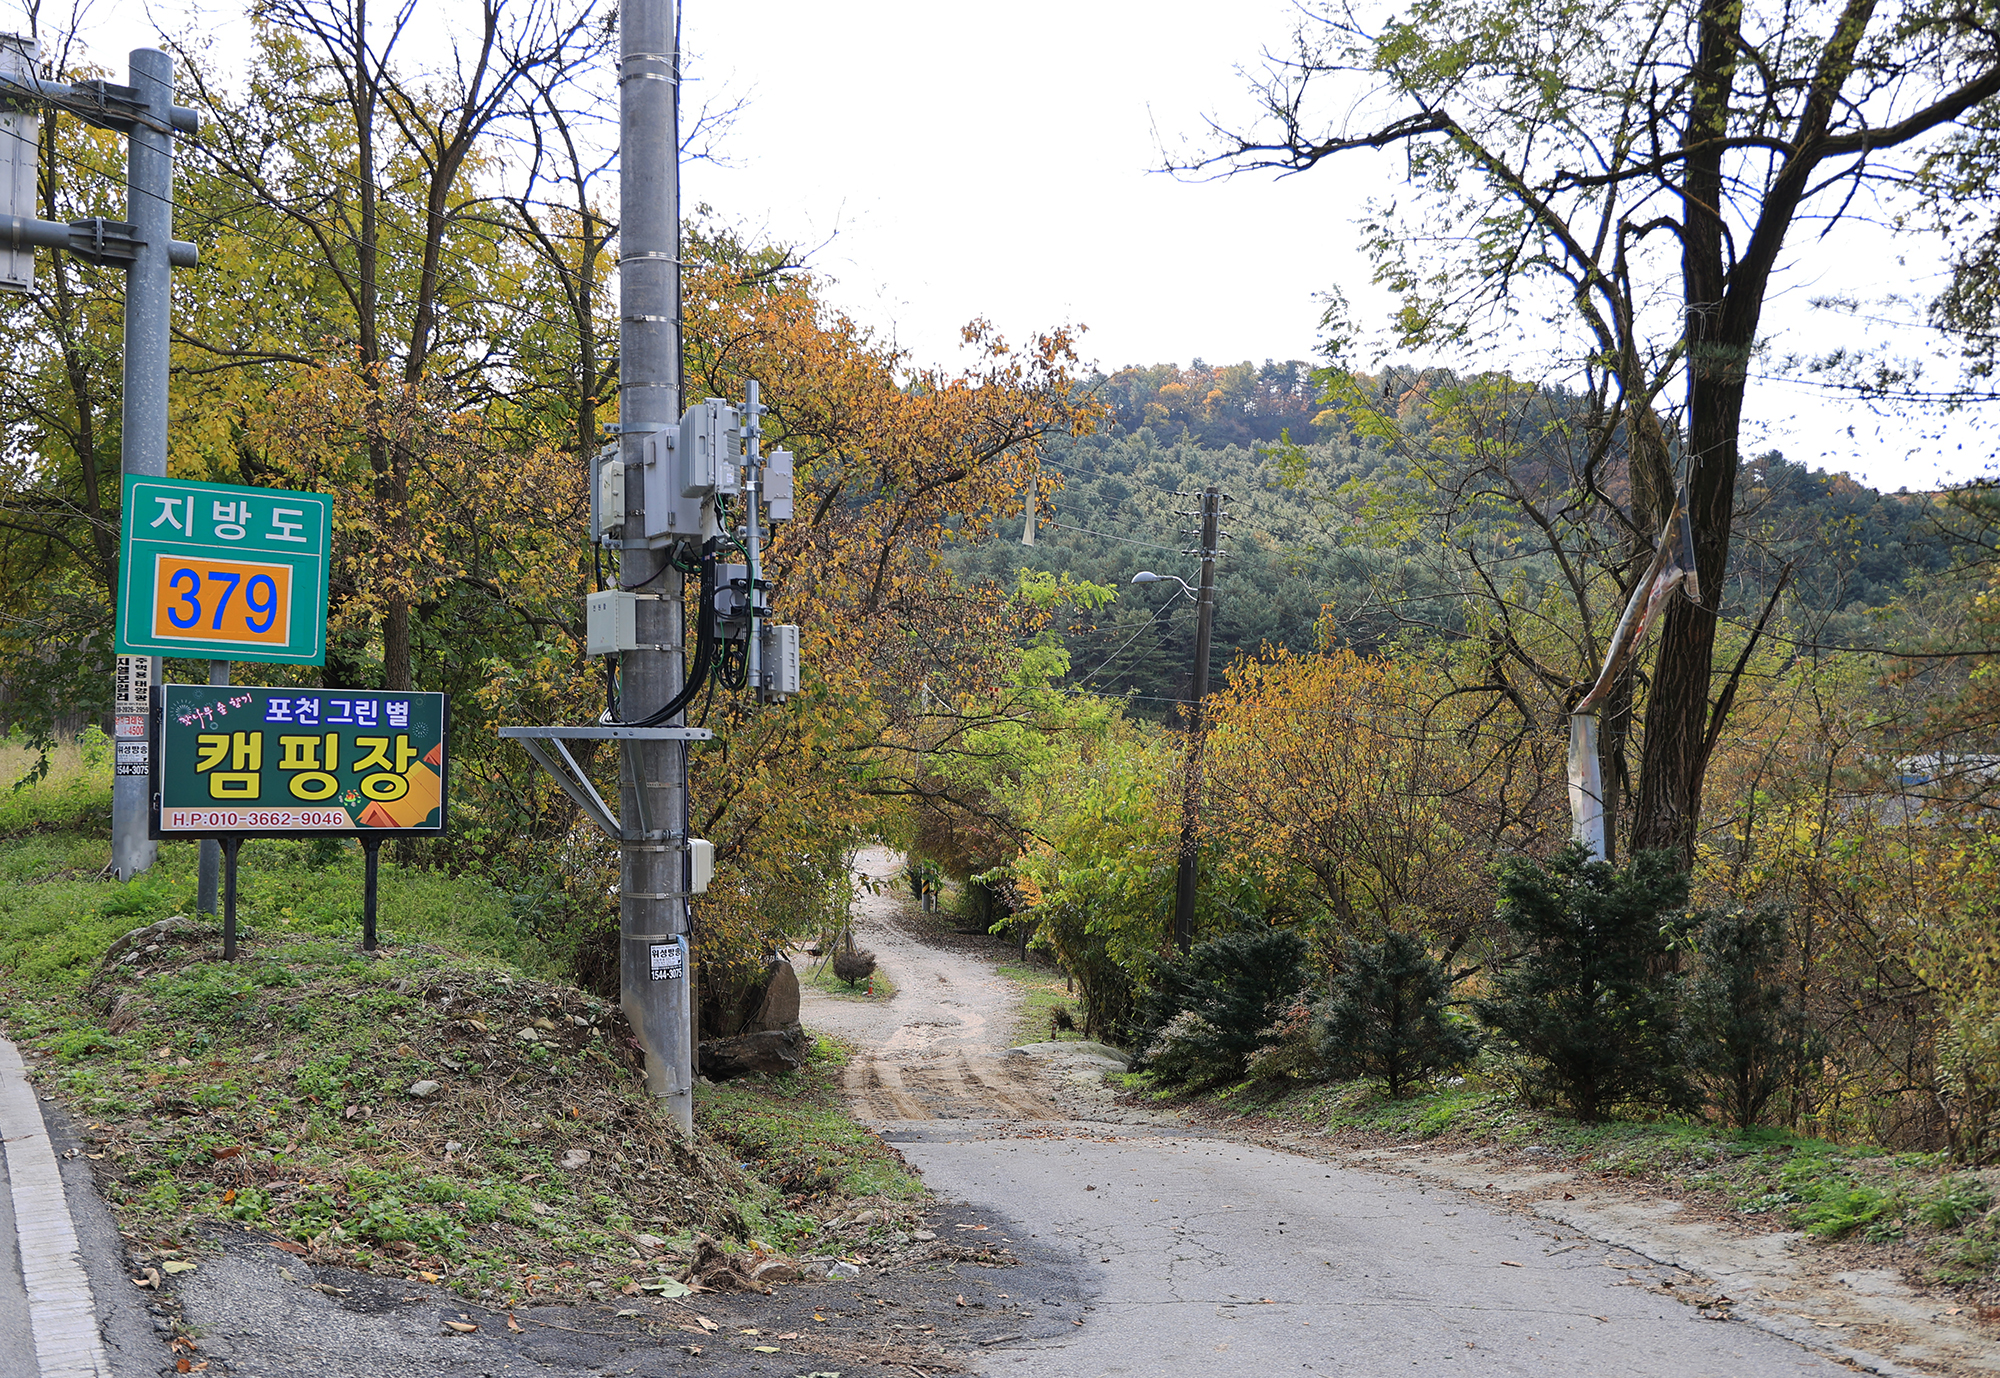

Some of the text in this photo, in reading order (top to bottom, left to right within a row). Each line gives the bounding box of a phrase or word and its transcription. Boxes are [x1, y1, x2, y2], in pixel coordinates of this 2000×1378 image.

[150, 496, 307, 543] 지방도
[167, 568, 278, 634] 379
[265, 697, 409, 727] 포천 그린 별
[196, 731, 418, 801] 캠핑장
[173, 812, 343, 827] H.P:010-3662-9046
